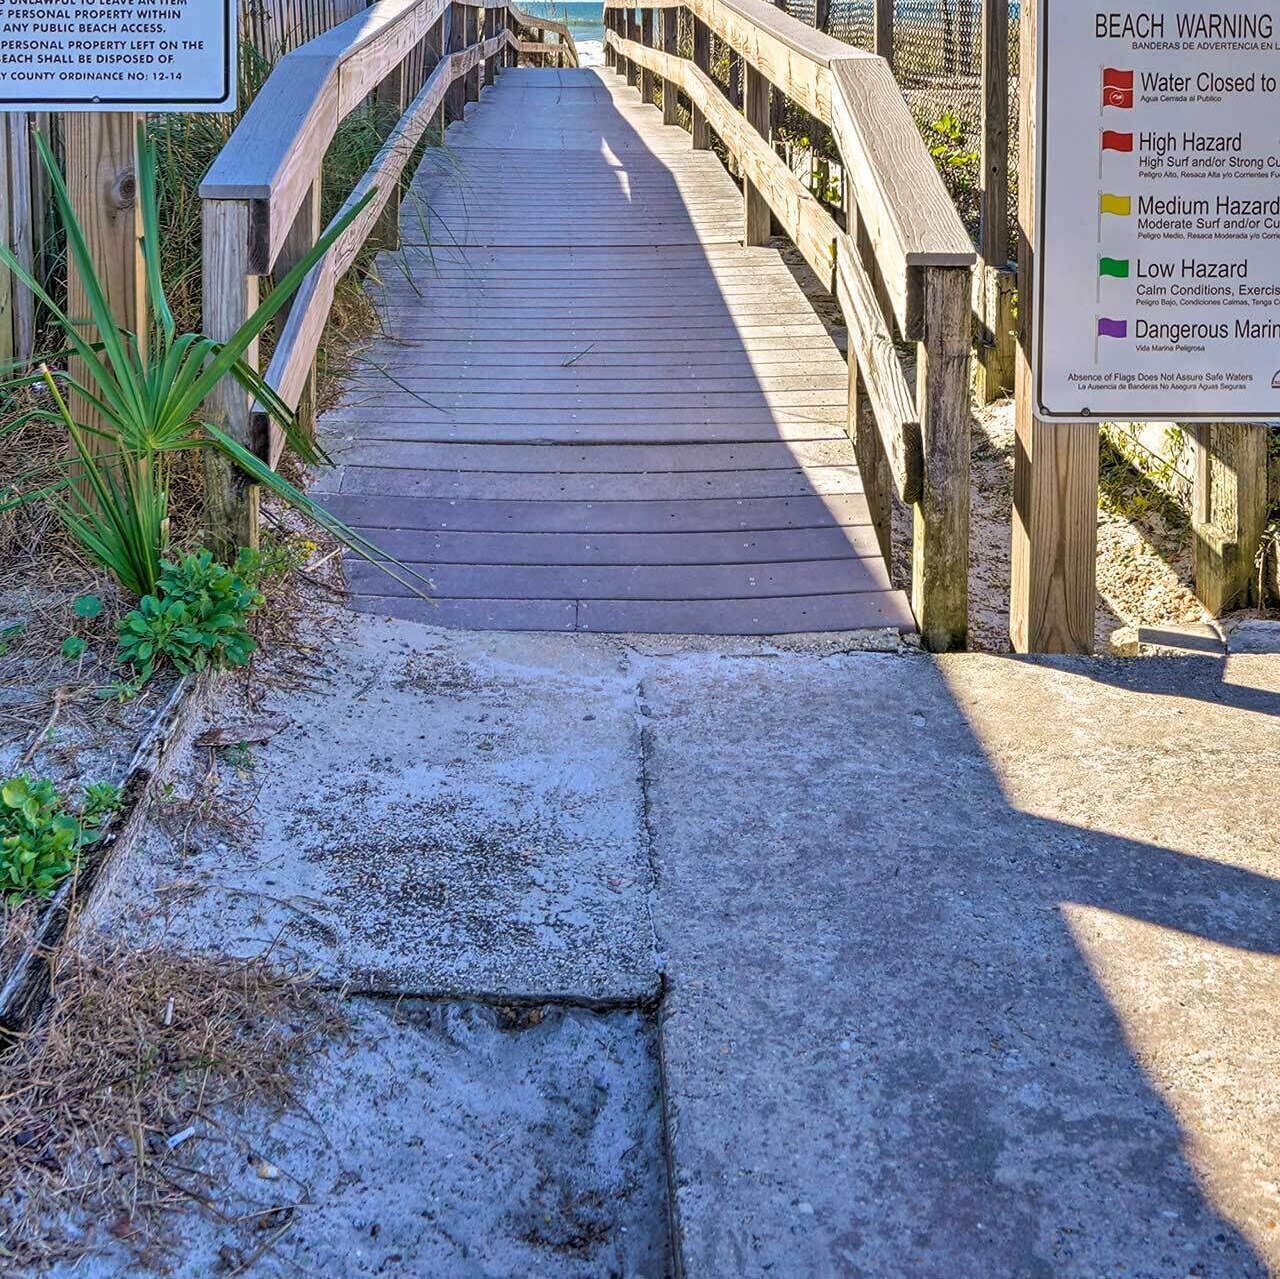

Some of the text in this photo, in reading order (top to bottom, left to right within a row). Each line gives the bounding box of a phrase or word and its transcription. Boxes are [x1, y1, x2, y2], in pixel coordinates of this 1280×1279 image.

[7, 9, 70, 18] PERSONAL
[74, 9, 133, 18] PROPERTY
[136, 9, 180, 19] WITHIN
[3, 23, 165, 33] ANY PUBLIC BEACH ACCESS.
[1095, 13, 1164, 38] BEACH
[1176, 13, 1272, 38] WARNING
[1, 40, 63, 49] PERSONAL
[68, 40, 126, 49] PROPERTY
[130, 40, 155, 49] LEFT
[159, 40, 177, 50] ON
[181, 40, 203, 49] THE
[1132, 41, 1180, 50] BANDERAS
[1182, 41, 1194, 49] DE
[1196, 41, 1259, 50] ADVERTENCIA
[1260, 41, 1273, 50] EN
[37, 54, 73, 63] SHALL
[78, 54, 91, 63] BE
[96, 54, 153, 63] DISPOSED
[10, 71, 55, 80] COUNTY
[59, 71, 123, 80] ORDINANCE
[152, 72, 181, 80] 12-14
[1140, 72, 1191, 91] Water
[1196, 72, 1254, 92] Closed
[1260, 73, 1276, 92] to
[1139, 131, 1241, 156] High Hazard
[1139, 155, 1163, 169] High
[1166, 156, 1189, 167] Surf
[1191, 156, 1226, 167] and/or
[1228, 156, 1263, 170] Strong
[1138, 195, 1280, 215] Medium Hazard
[1137, 218, 1192, 229] Moderate
[1196, 217, 1220, 229] Surf
[1223, 218, 1260, 229] and/or
[1137, 259, 1247, 278] Low Hazard
[1136, 284, 1166, 295] Calm
[1170, 284, 1234, 296] Conditions,
[1135, 319, 1228, 343] Dangerous
[1175, 344, 1205, 353] Peligrosa
[1067, 372, 1253, 383] Absence of Flags Does Not Assure Safe Waters
